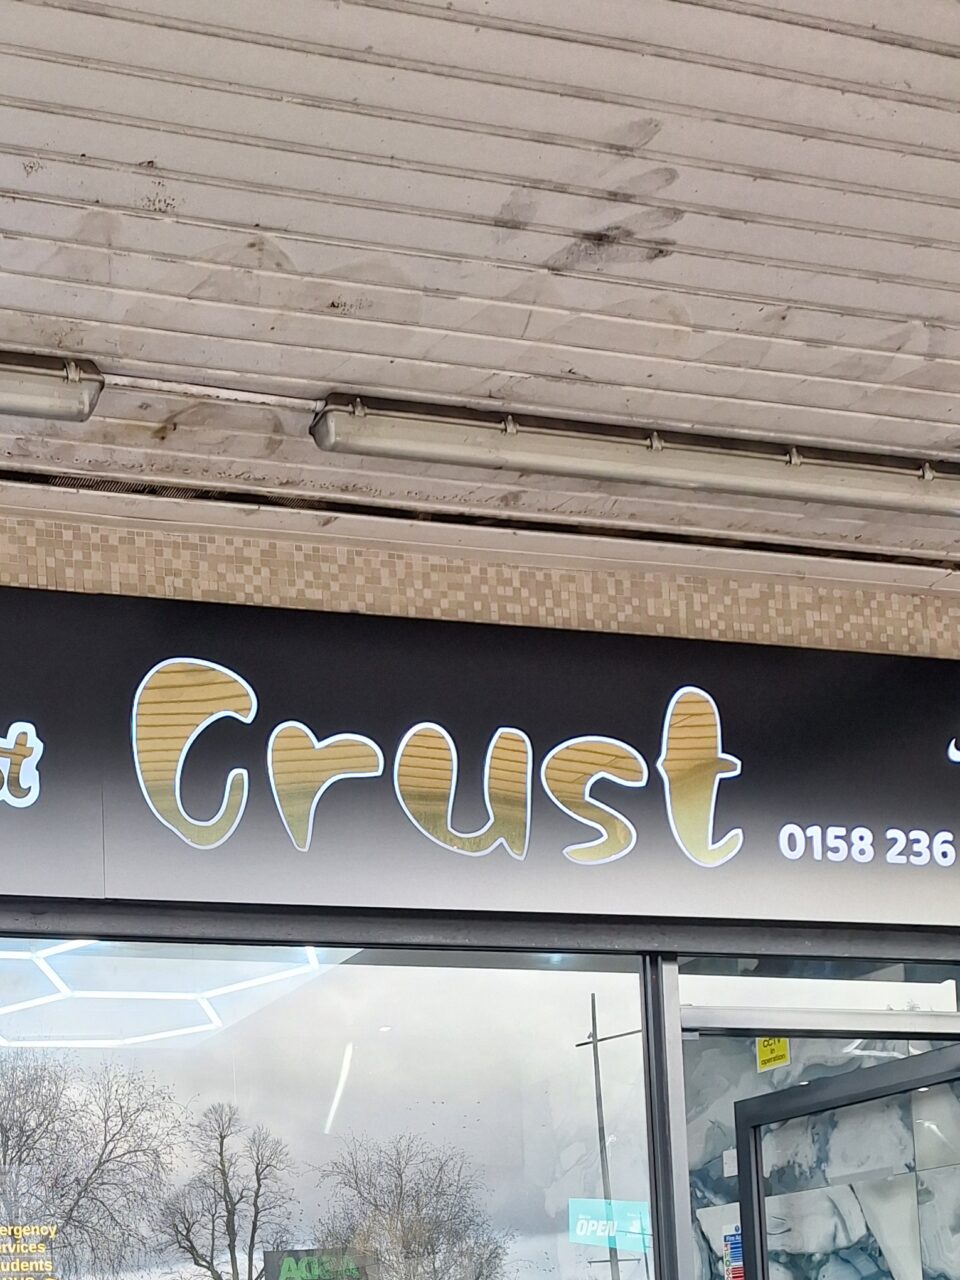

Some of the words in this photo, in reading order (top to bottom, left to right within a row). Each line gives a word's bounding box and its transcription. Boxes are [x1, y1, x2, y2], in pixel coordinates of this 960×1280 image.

[132, 657, 744, 867] Crust
[778, 823, 875, 863] 0158
[885, 829, 957, 867] 236
[761, 1054, 785, 1065] operation
[577, 1220, 616, 1236] OPEN
